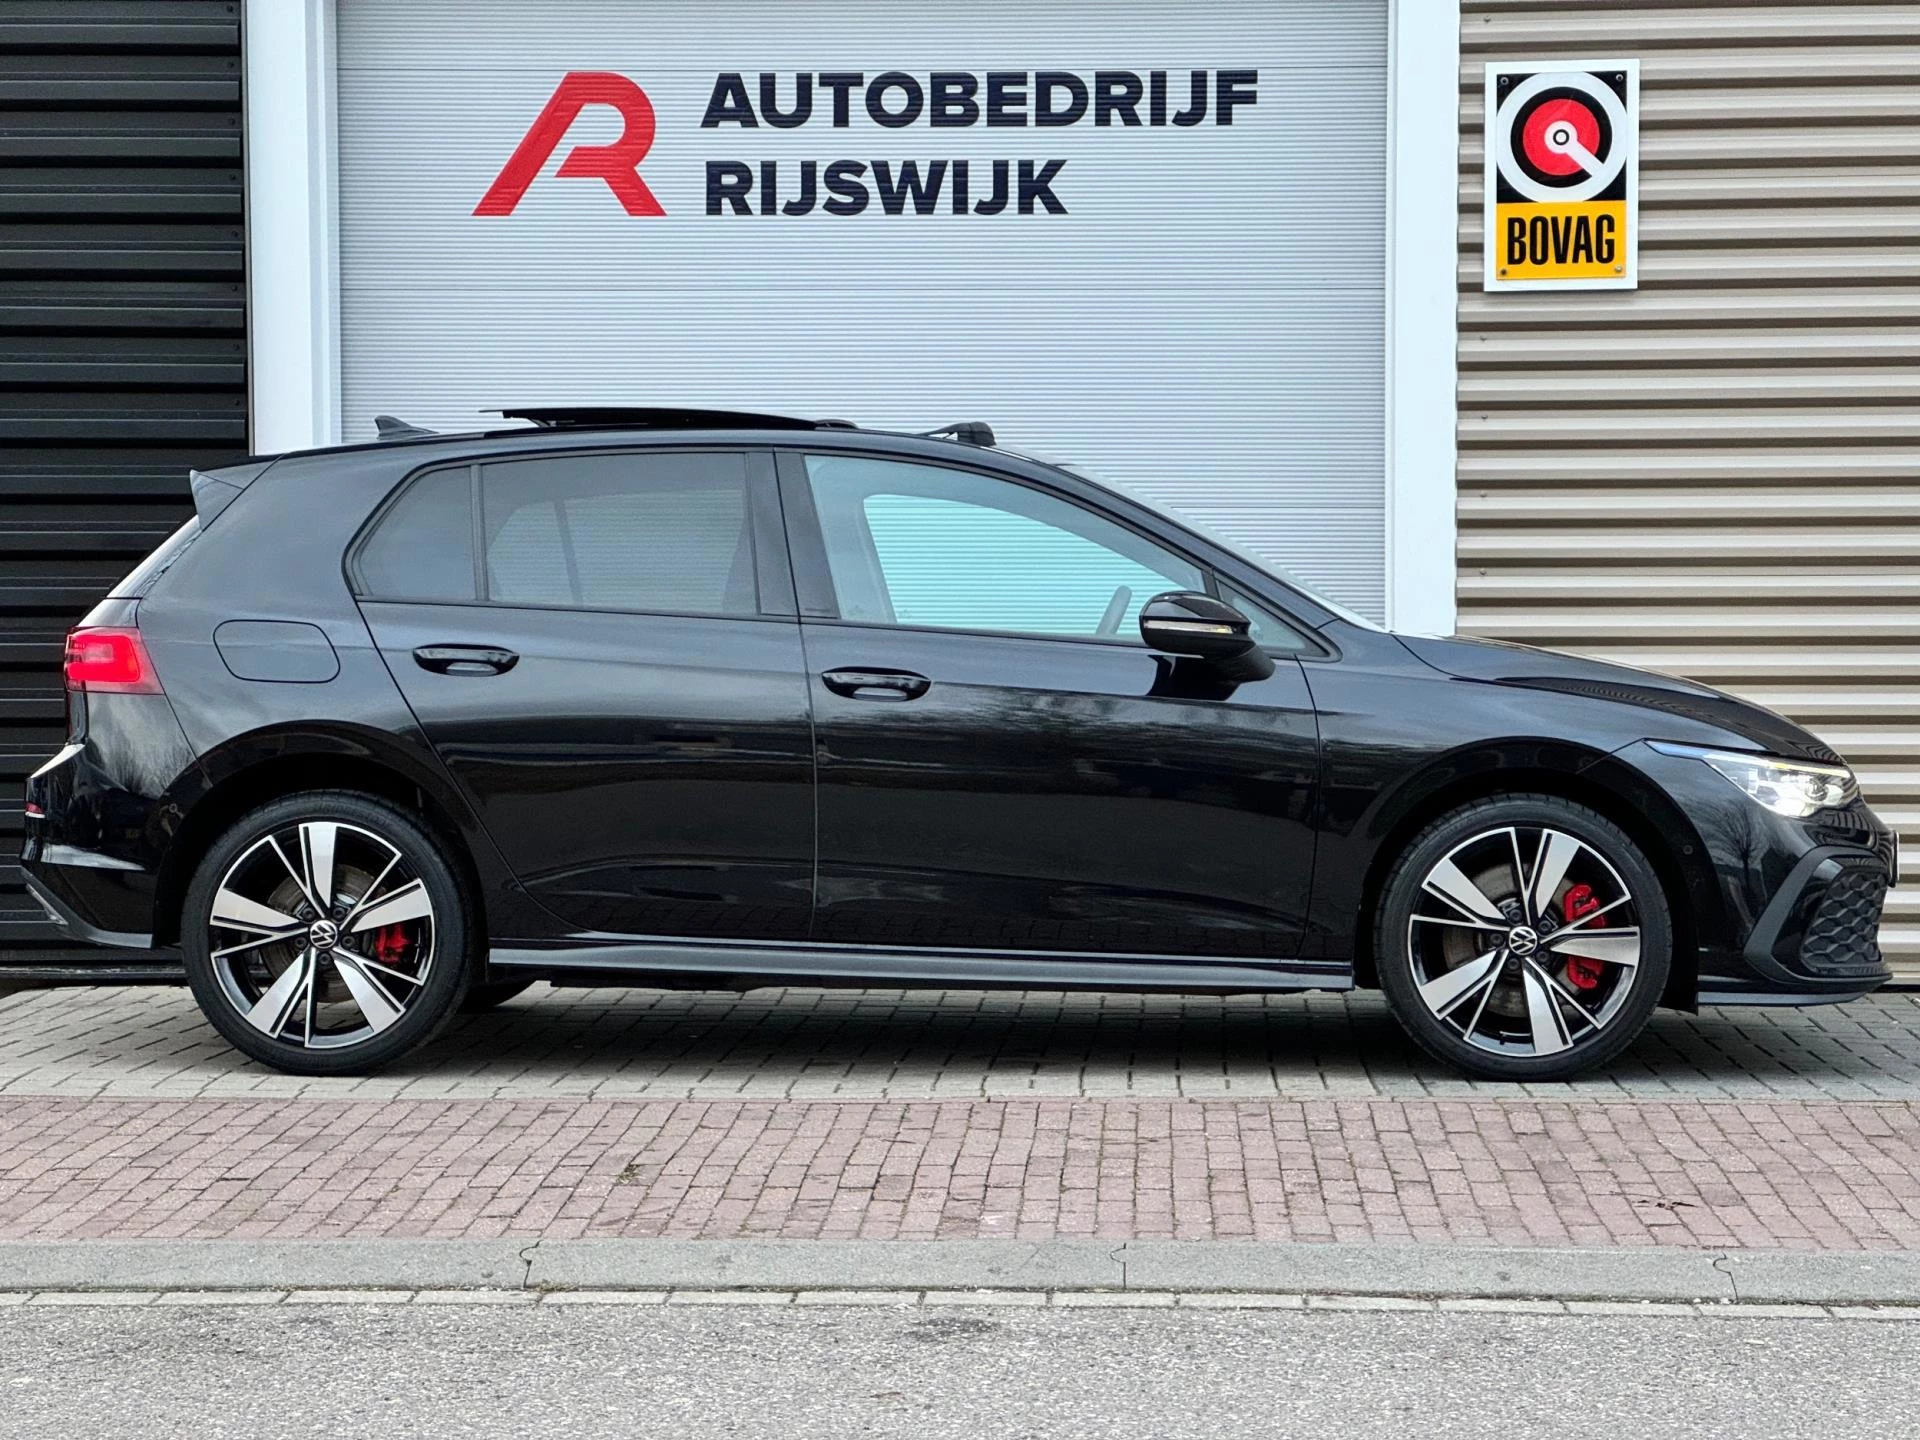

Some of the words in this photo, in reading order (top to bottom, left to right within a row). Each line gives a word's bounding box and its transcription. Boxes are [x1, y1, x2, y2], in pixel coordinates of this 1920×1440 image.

[701, 69, 1258, 129] AUTOBEDRIJF
[705, 159, 1068, 217] RIJSWIJK
[1507, 214, 1615, 266] BOVAG
